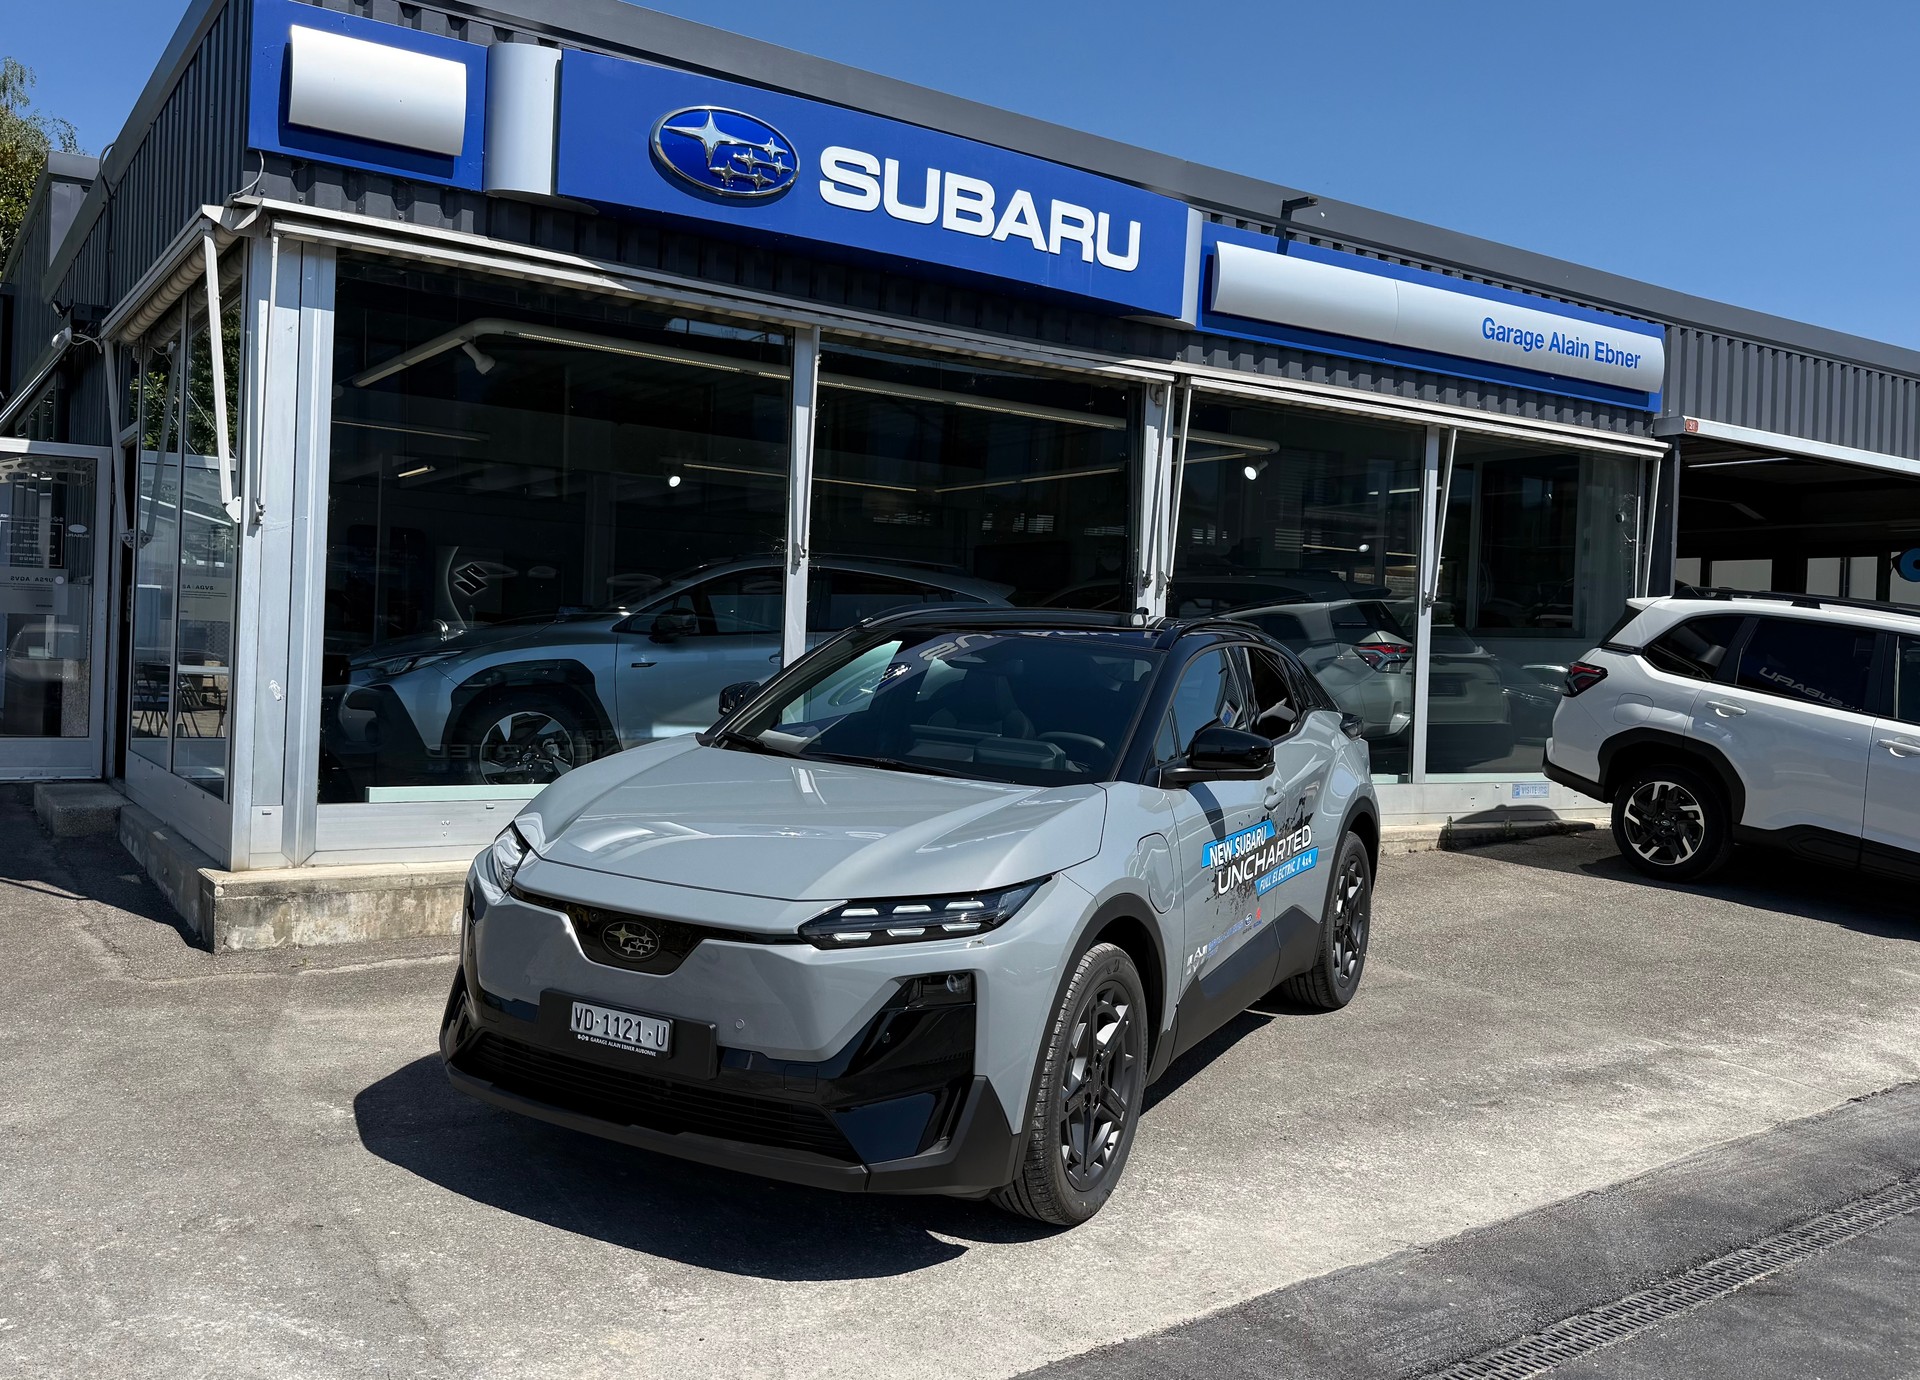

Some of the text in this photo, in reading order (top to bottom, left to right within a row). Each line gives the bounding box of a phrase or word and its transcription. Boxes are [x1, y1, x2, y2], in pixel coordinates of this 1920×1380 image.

[819, 146, 1141, 272] SUBARU
[1482, 317, 1641, 369] Garage Alain Ebner
[1209, 826, 1267, 868] NEW SUBARU
[1217, 824, 1312, 895] UNCHARTED
[1259, 875, 1271, 891] FULL
[1272, 861, 1295, 884] ELECTRIC
[1302, 853, 1312, 867] 4x4
[590, 1037, 607, 1046] GARAGE
[621, 1044, 635, 1052] EBNER
[635, 1047, 656, 1057] AUBONNE
